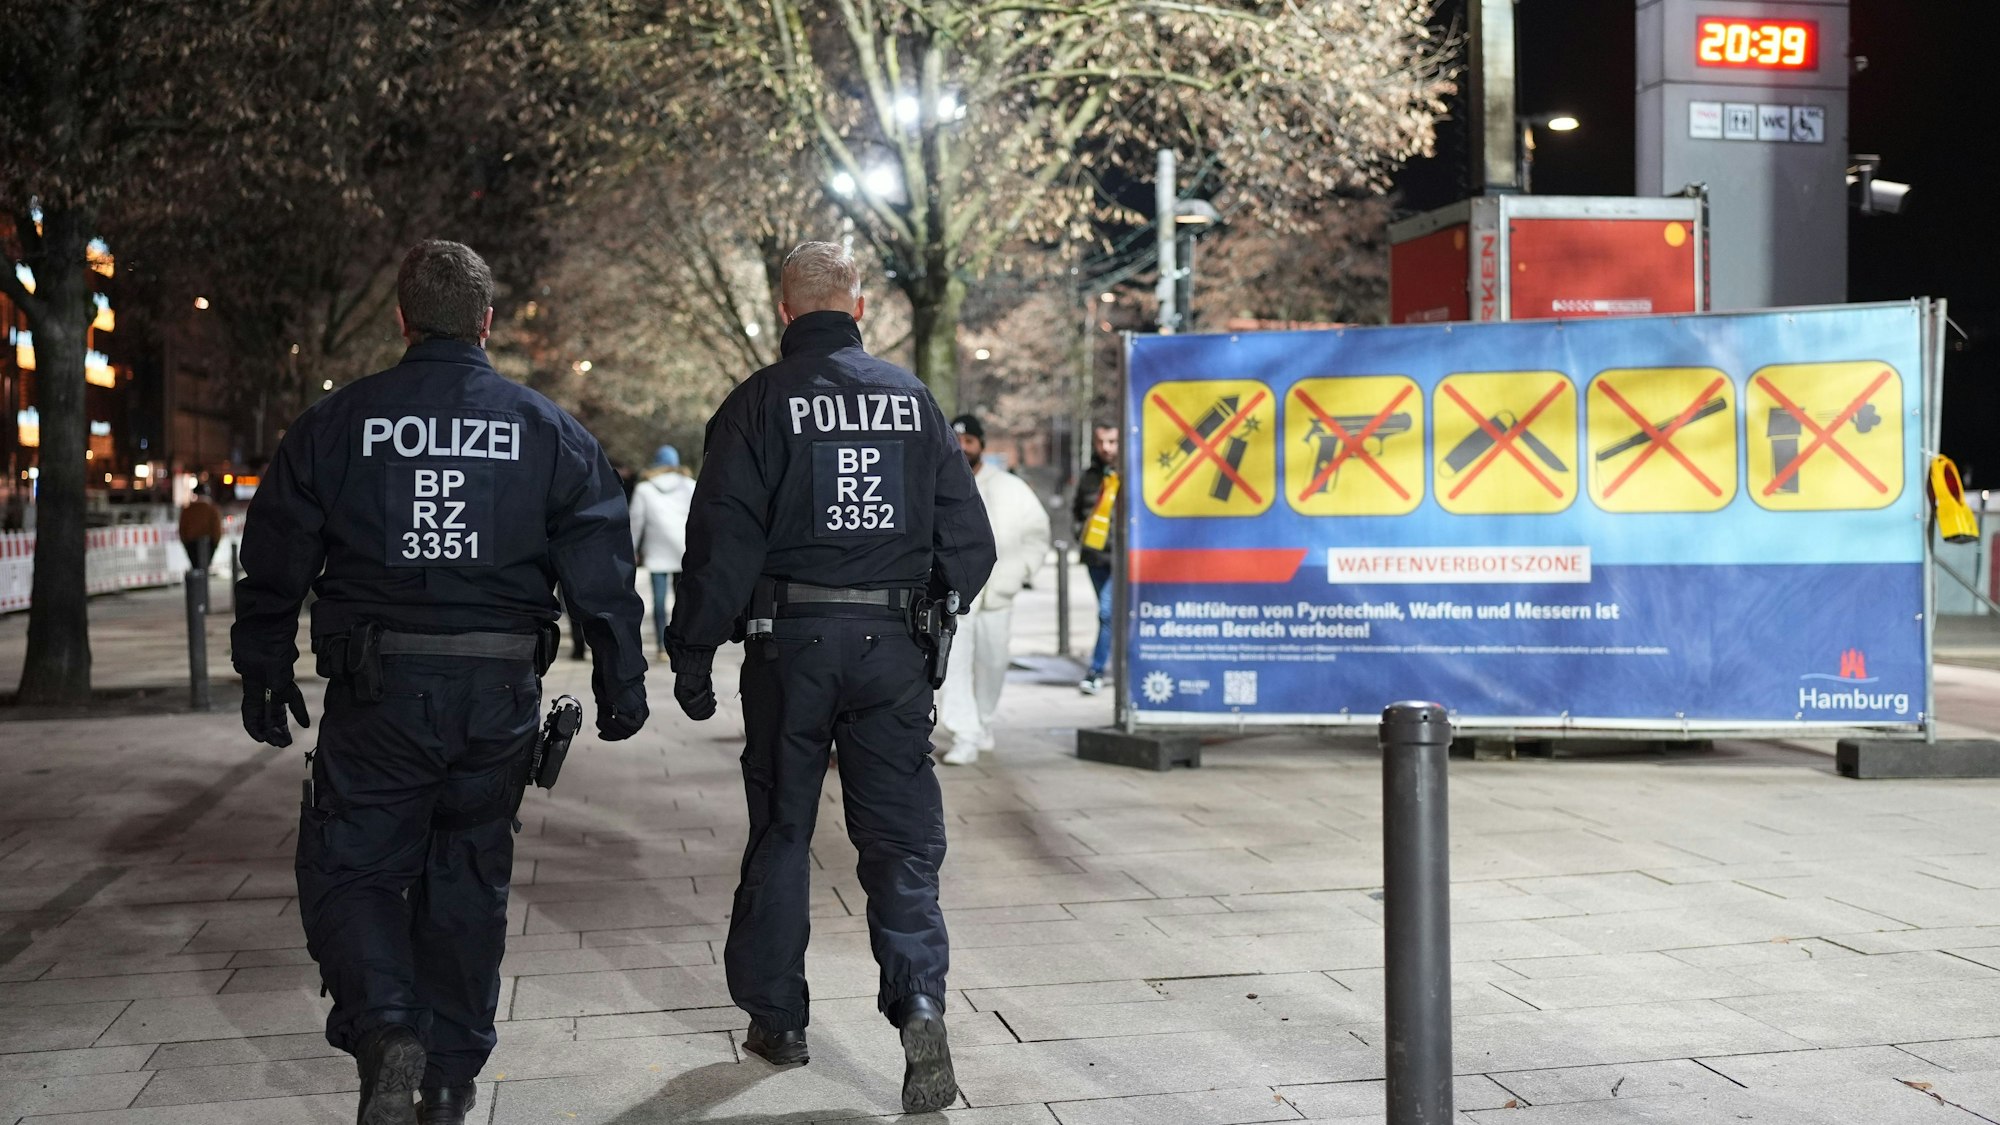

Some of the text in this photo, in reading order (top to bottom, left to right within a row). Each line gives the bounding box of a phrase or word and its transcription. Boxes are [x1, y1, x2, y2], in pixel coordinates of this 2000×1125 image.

[1701, 23, 1806, 65] 20:39
[1763, 116, 1785, 129] WC
[788, 394, 922, 434] POLIZEI
[362, 415, 520, 461] POLIZEI
[837, 447, 881, 474] BP
[414, 469, 466, 498] BP
[837, 476, 883, 503] RZ
[413, 501, 467, 529] RZ
[826, 503, 895, 531] 3352
[401, 531, 479, 560] 3351
[1337, 555, 1582, 573] WAFFENVERBOTSZONE
[1139, 602, 1620, 622] Das Mitführen von Pyrotechnik, Waffen und Messern ist
[1139, 621, 1371, 639] in diesem Bereich verboten!
[1799, 687, 1908, 714] Hamburg
